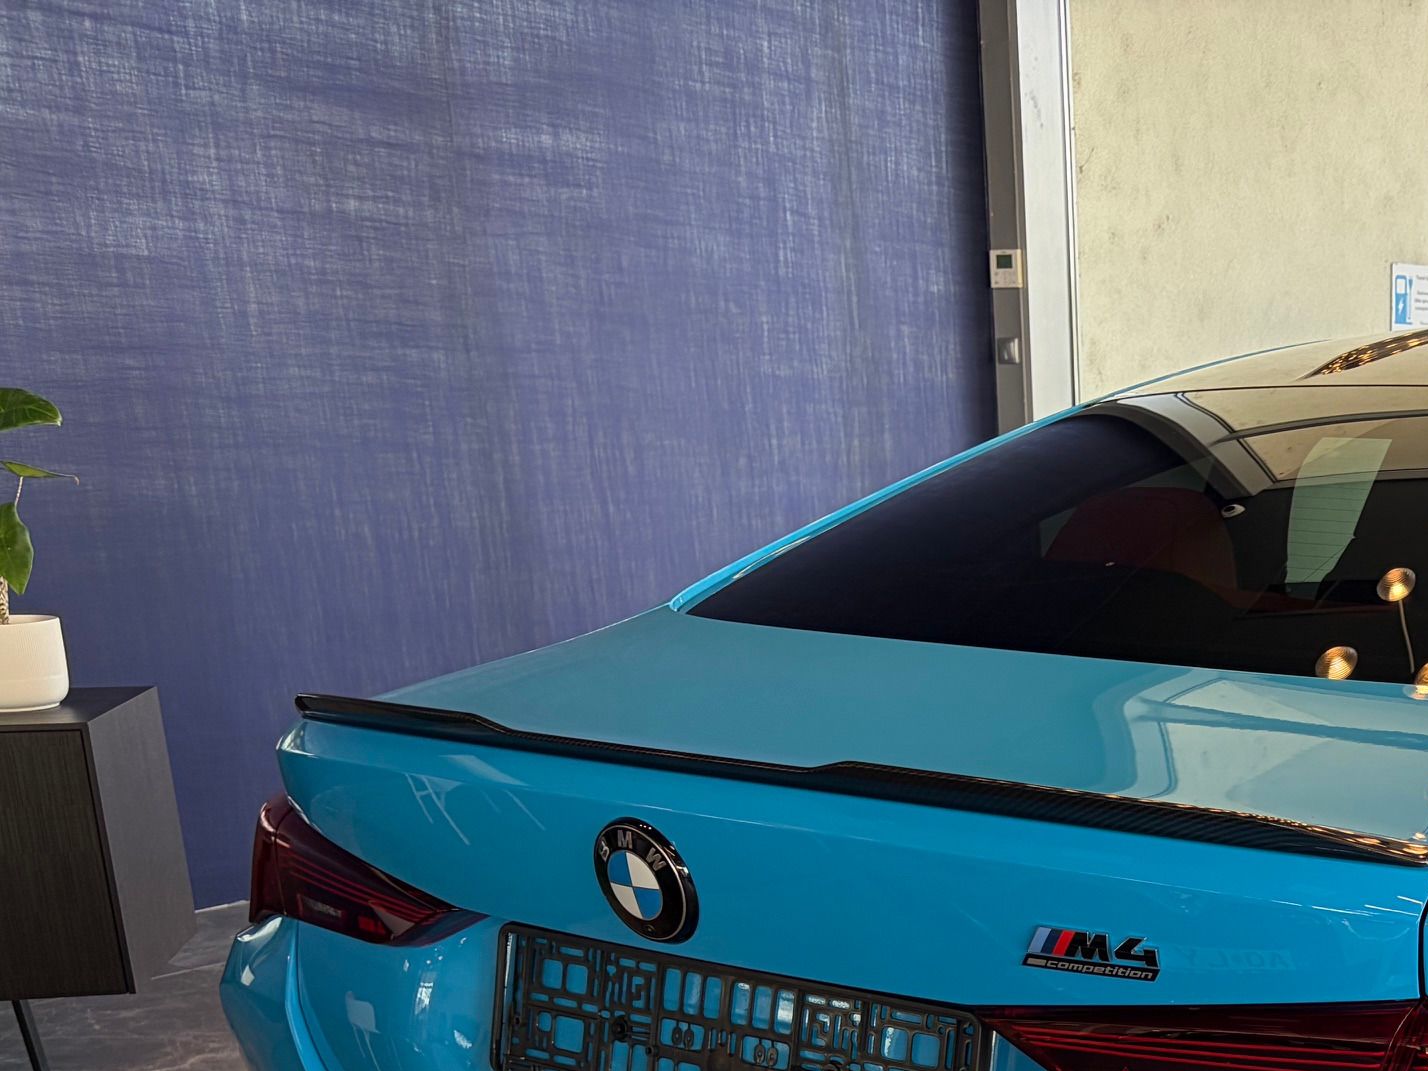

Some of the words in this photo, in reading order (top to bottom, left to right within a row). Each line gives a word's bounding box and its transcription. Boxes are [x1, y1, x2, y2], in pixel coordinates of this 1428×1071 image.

[598, 829, 668, 872] BMW
[1067, 930, 1160, 969] M4
[1046, 959, 1154, 980] competition
